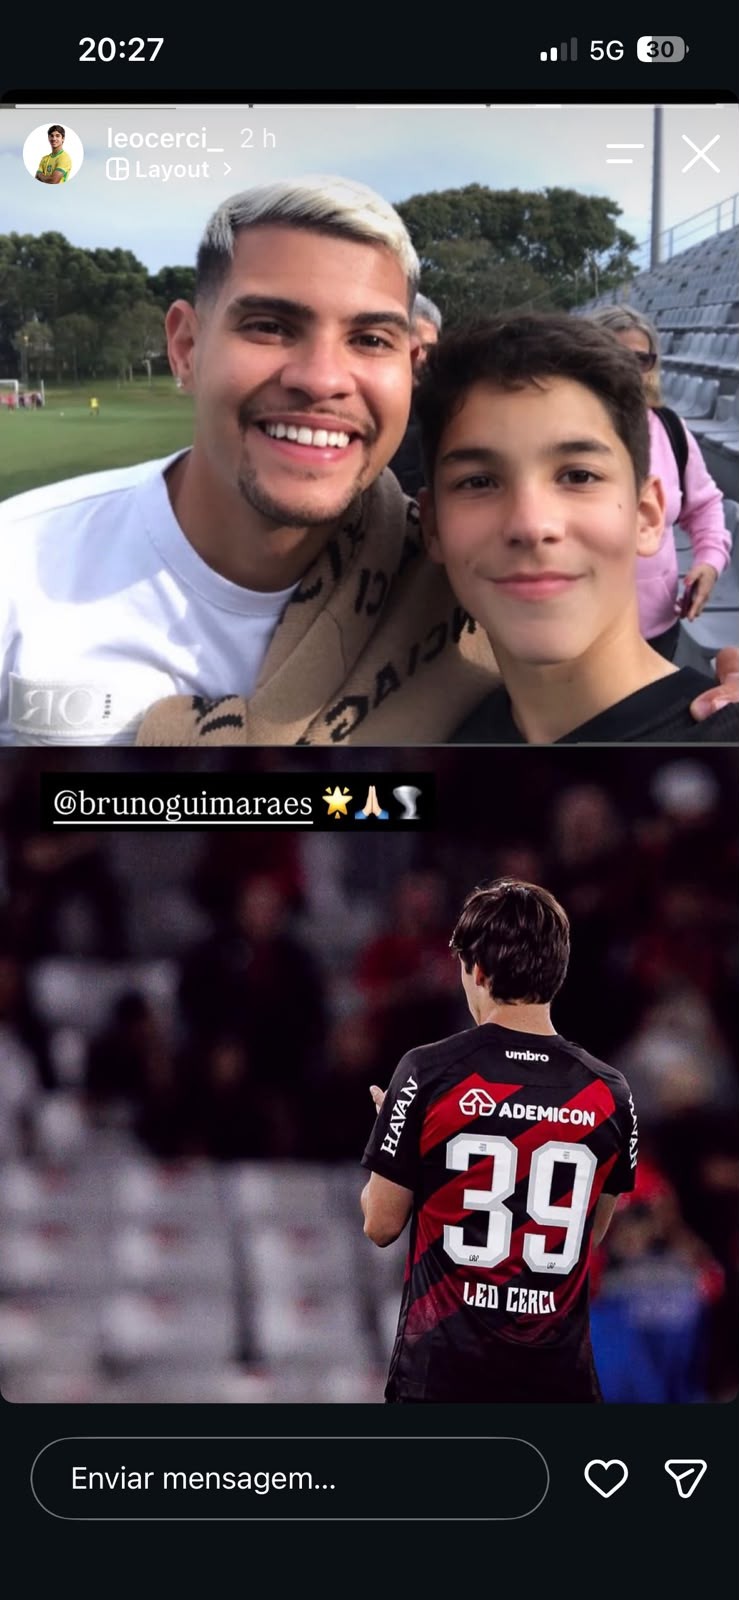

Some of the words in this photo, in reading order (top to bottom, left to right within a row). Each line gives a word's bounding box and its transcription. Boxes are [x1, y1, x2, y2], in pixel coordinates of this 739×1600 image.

[505, 1050, 550, 1063] umbro
[380, 1076, 420, 1158] HAVAN
[499, 1102, 596, 1128] ADEMICON
[443, 1132, 598, 1275] 39
[463, 1281, 499, 1309] LEO
[505, 1286, 557, 1315] CERCI
